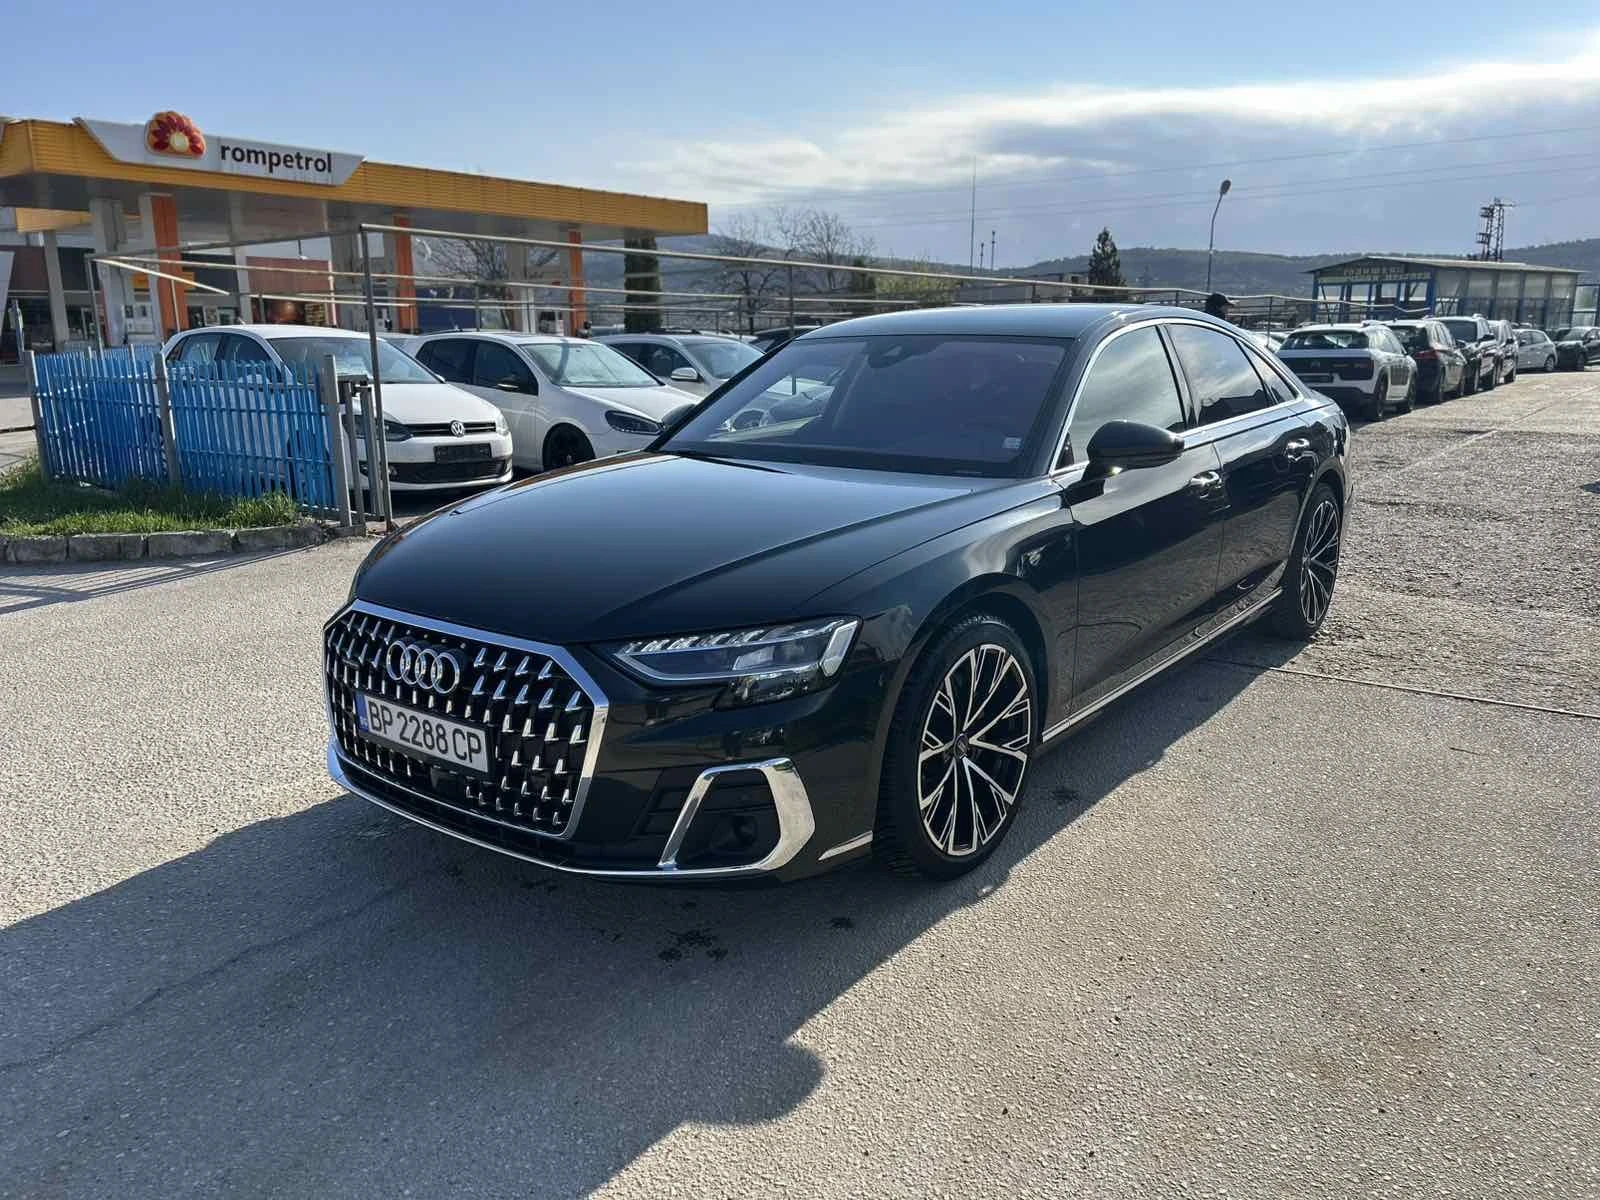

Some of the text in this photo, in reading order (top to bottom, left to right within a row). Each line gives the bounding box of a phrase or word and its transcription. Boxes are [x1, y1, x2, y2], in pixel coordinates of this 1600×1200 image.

[221, 145, 332, 173] rompetrol
[369, 702, 482, 763] BP 2288 CP
